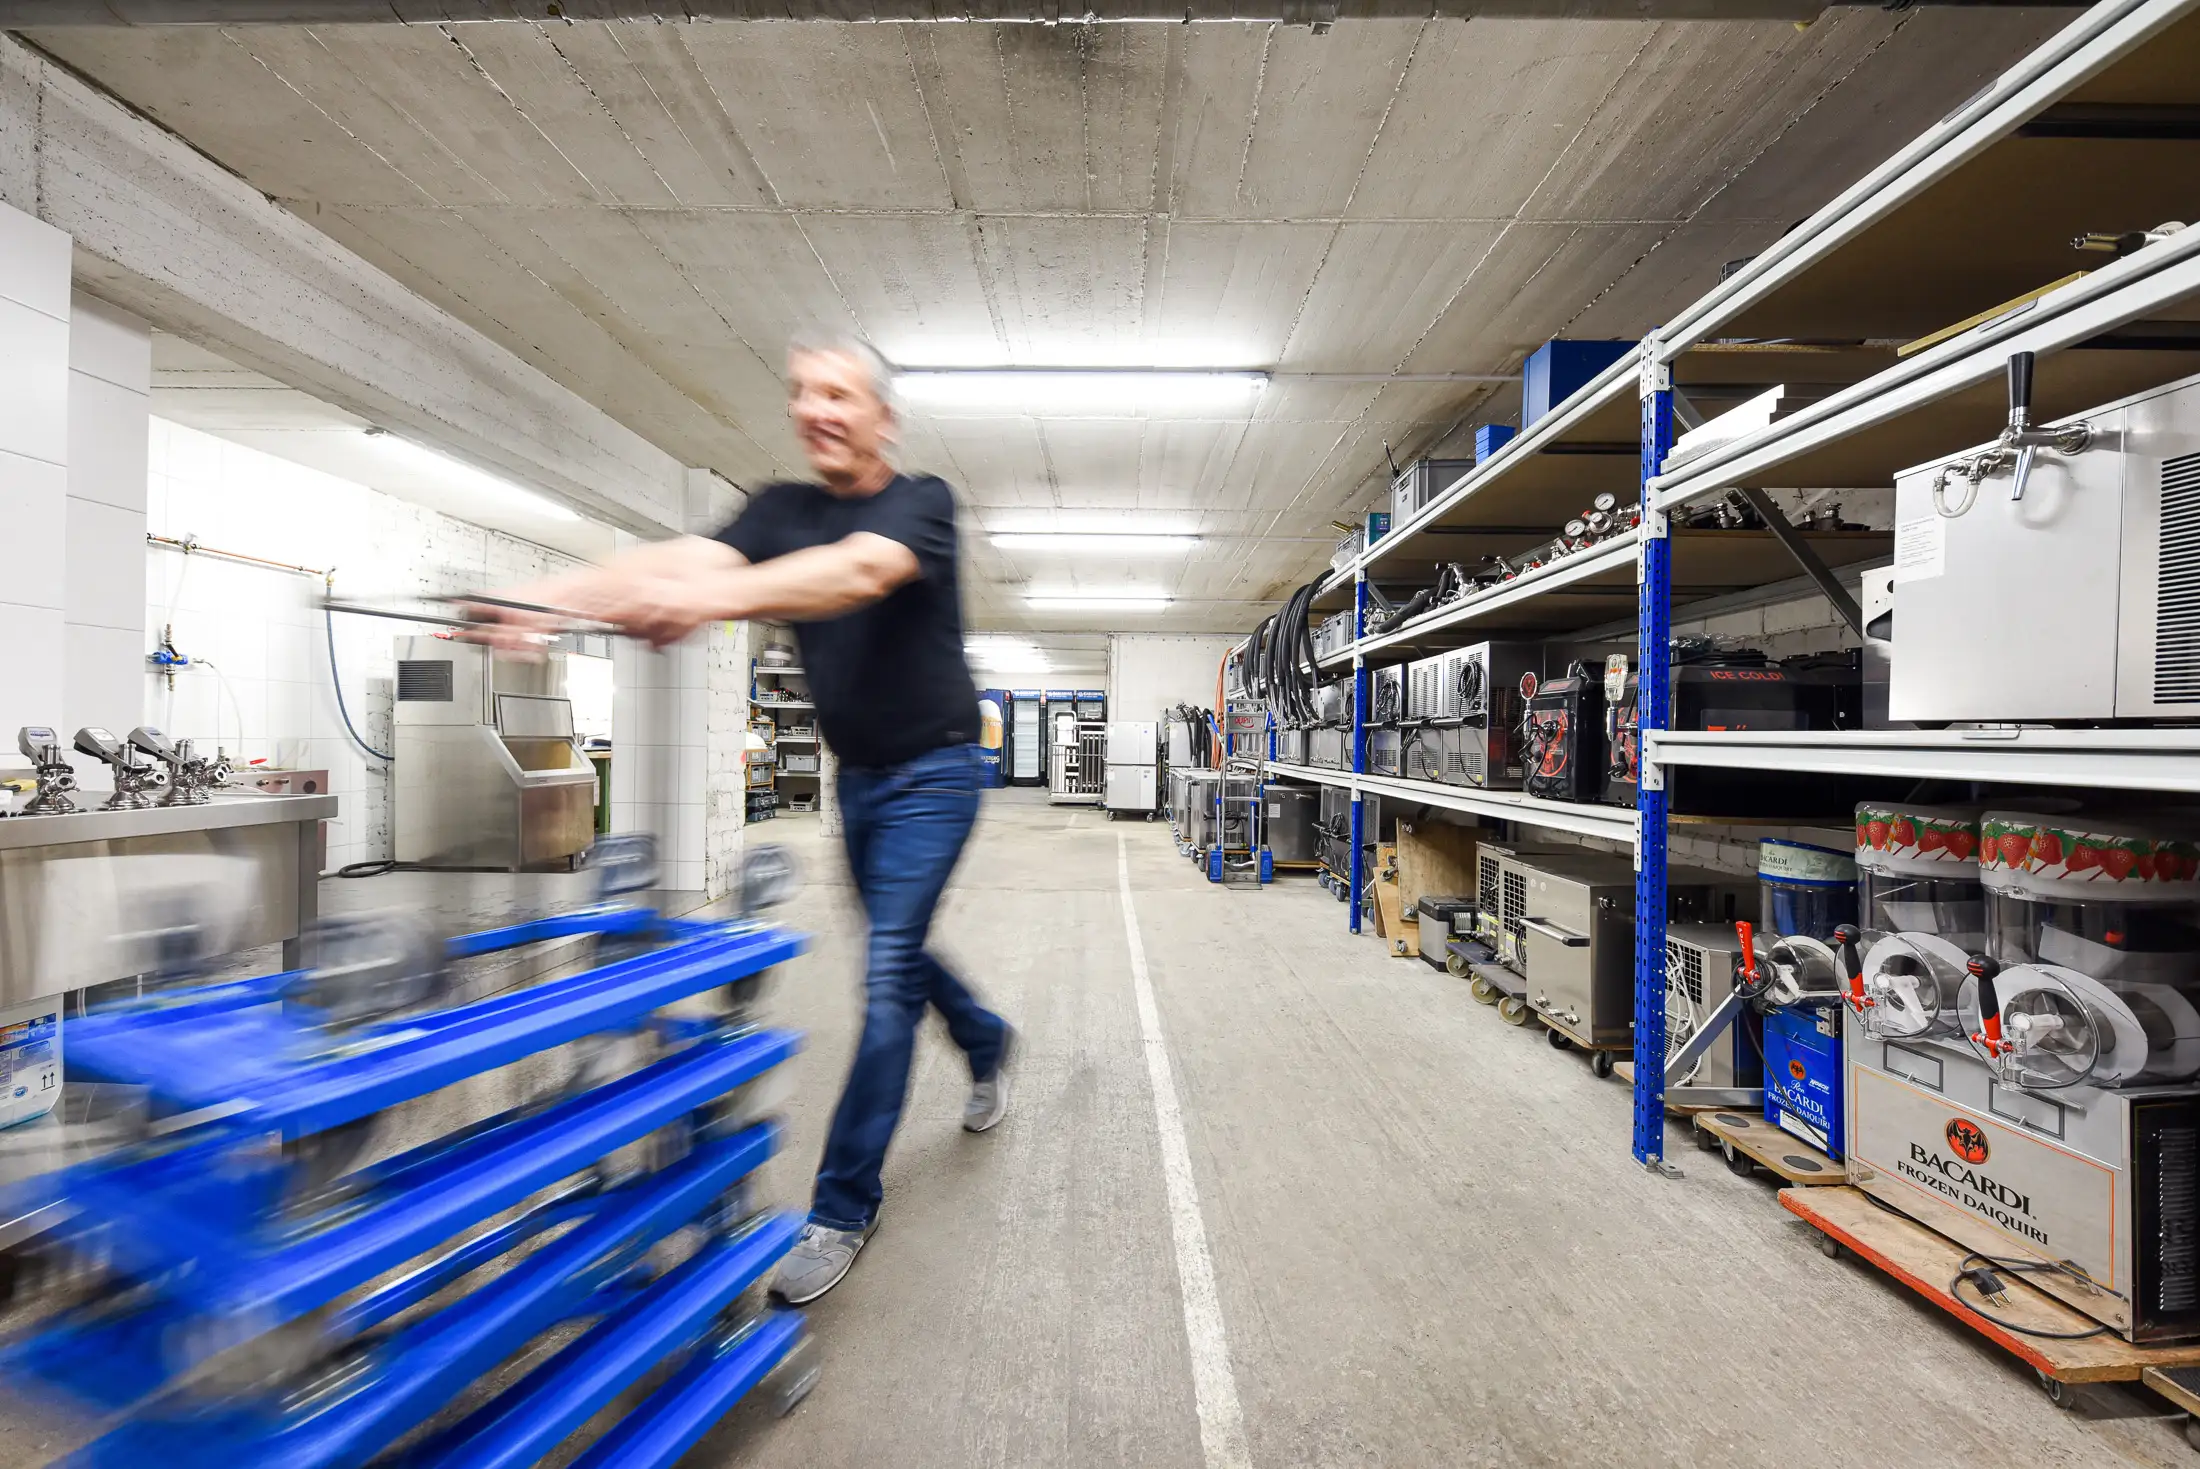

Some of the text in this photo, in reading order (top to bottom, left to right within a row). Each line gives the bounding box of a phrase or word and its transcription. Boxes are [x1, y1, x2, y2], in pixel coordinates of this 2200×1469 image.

[1710, 671, 1786, 681] ICE COLD!
[1791, 1080, 1806, 1094] Ron
[1796, 1107, 1831, 1129] DAIQUIRI
[1897, 1160, 2048, 1246] FROZEN DAIQUIRI
